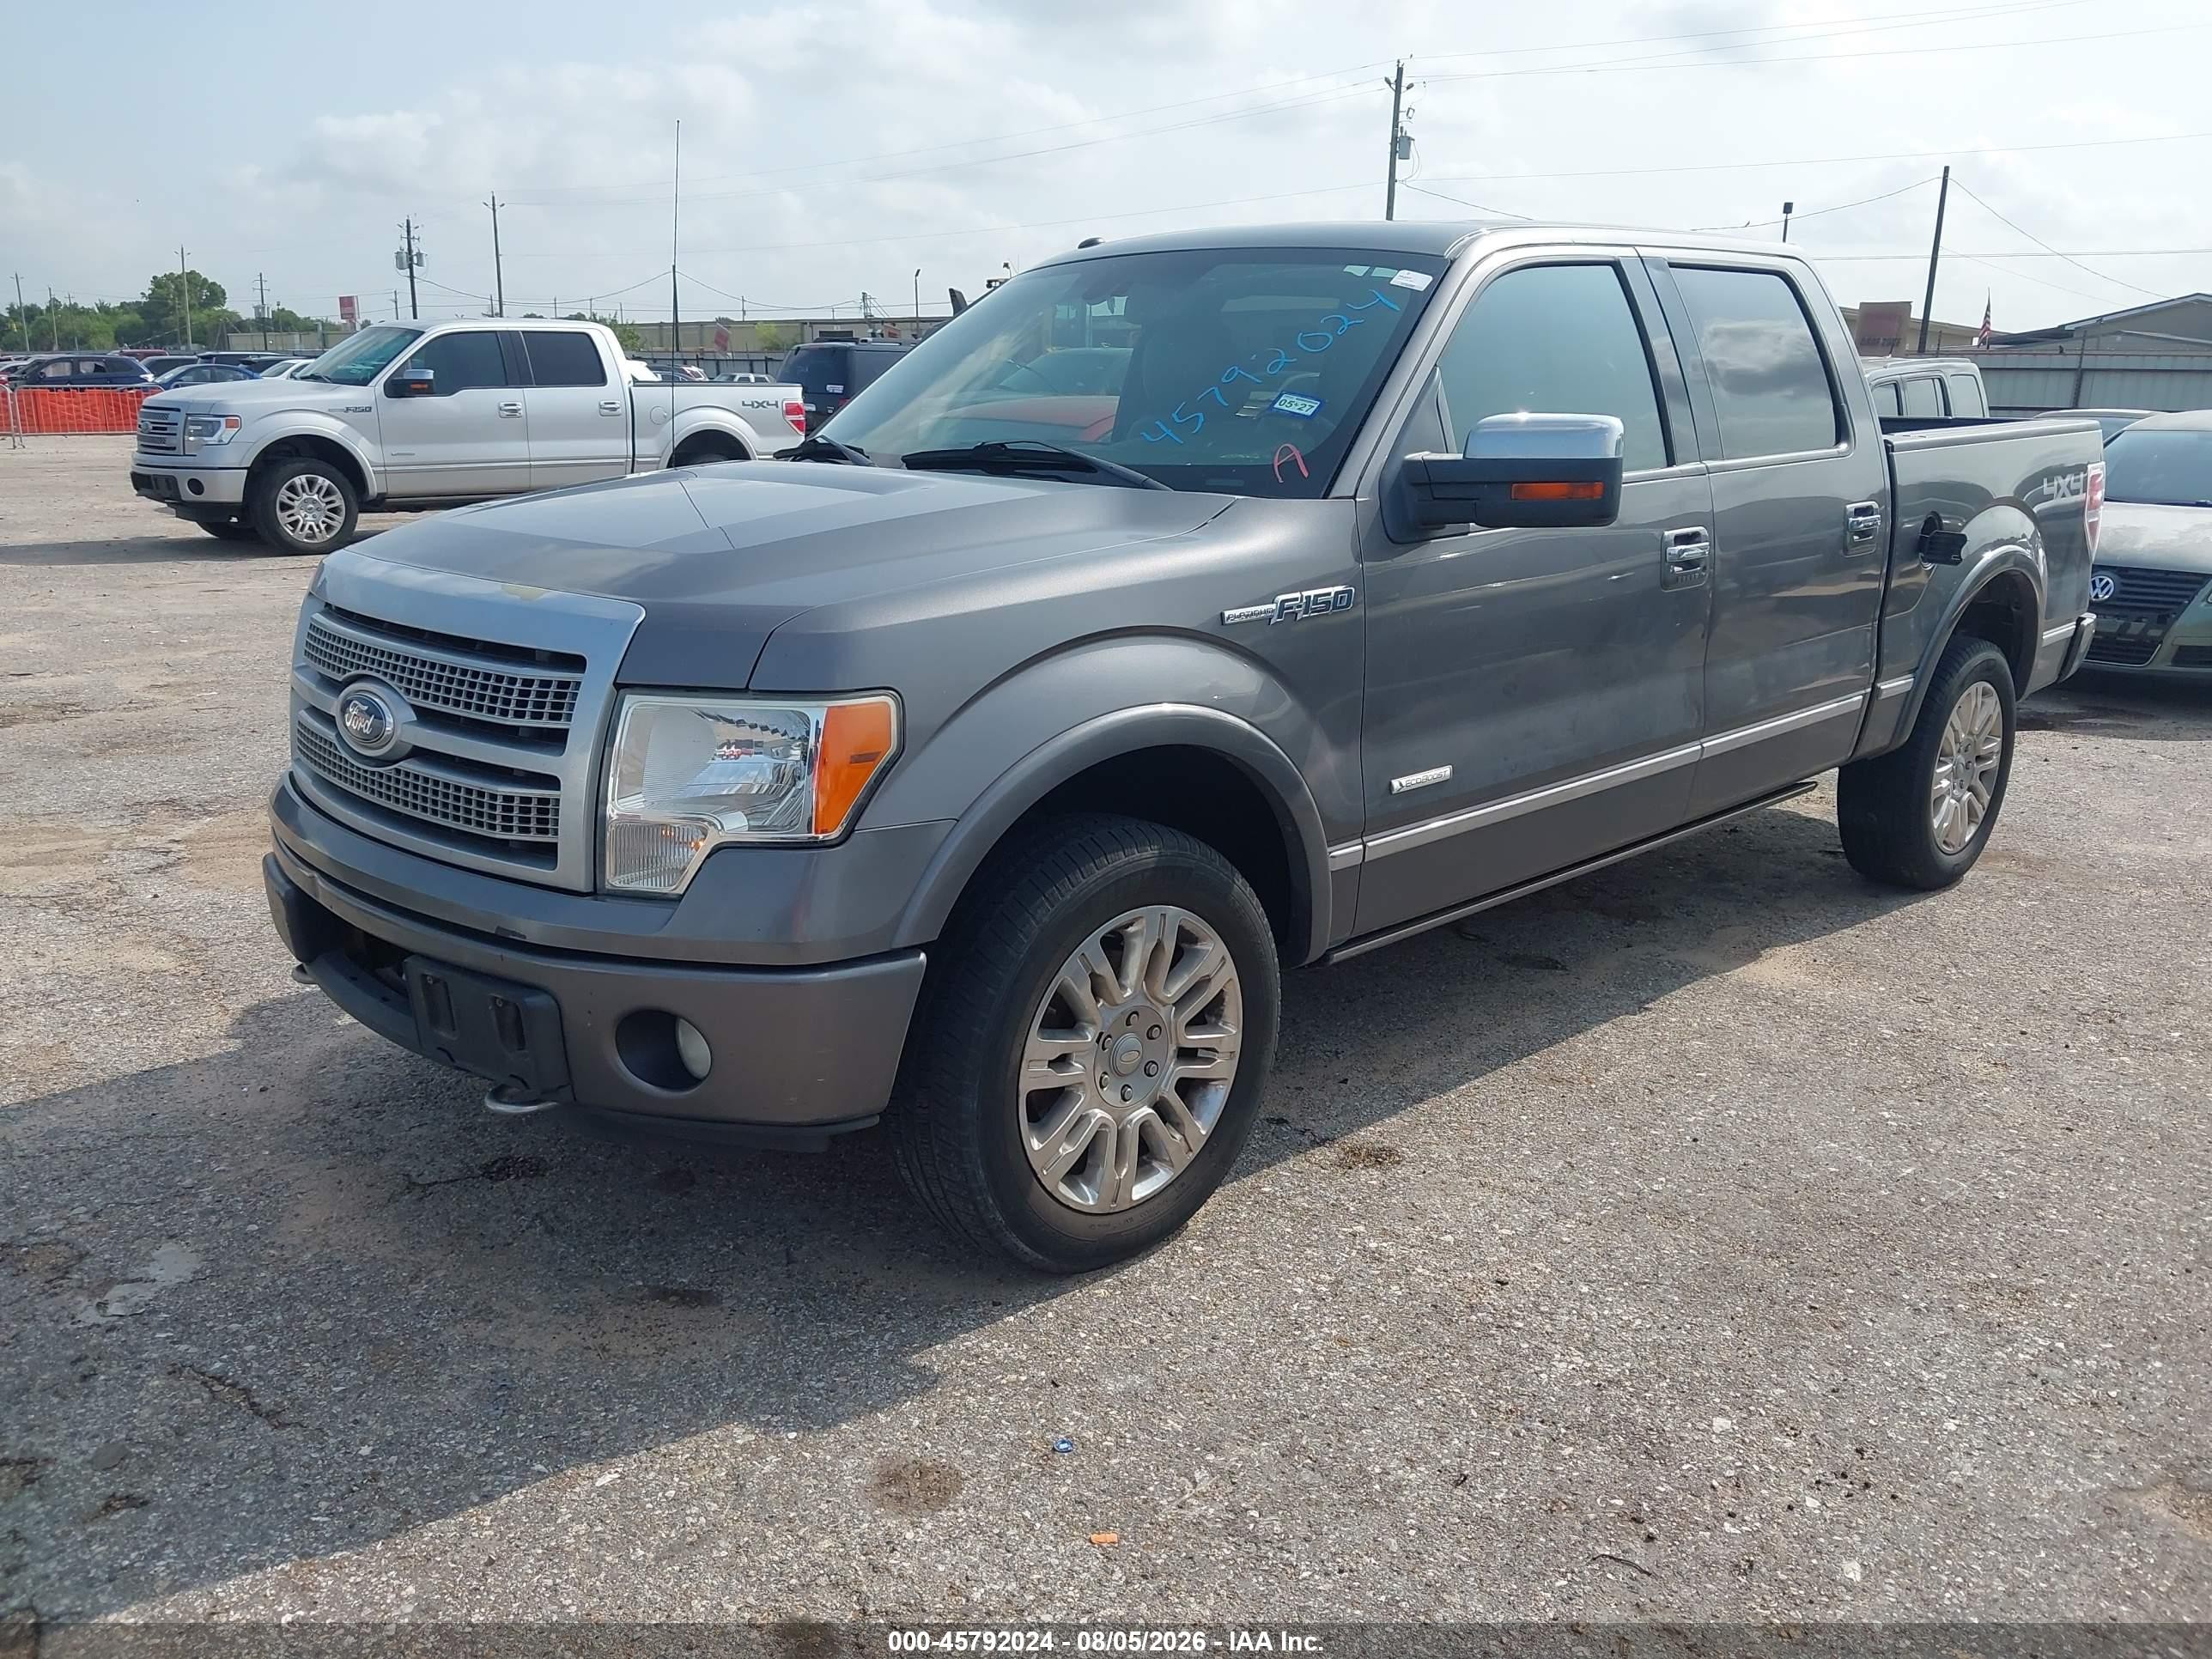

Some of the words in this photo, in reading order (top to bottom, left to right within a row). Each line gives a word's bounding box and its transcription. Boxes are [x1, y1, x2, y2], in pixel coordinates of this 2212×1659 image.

[1140, 289, 1401, 445] 45792024
[1273, 443, 1309, 483] A
[345, 700, 375, 734] Ford
